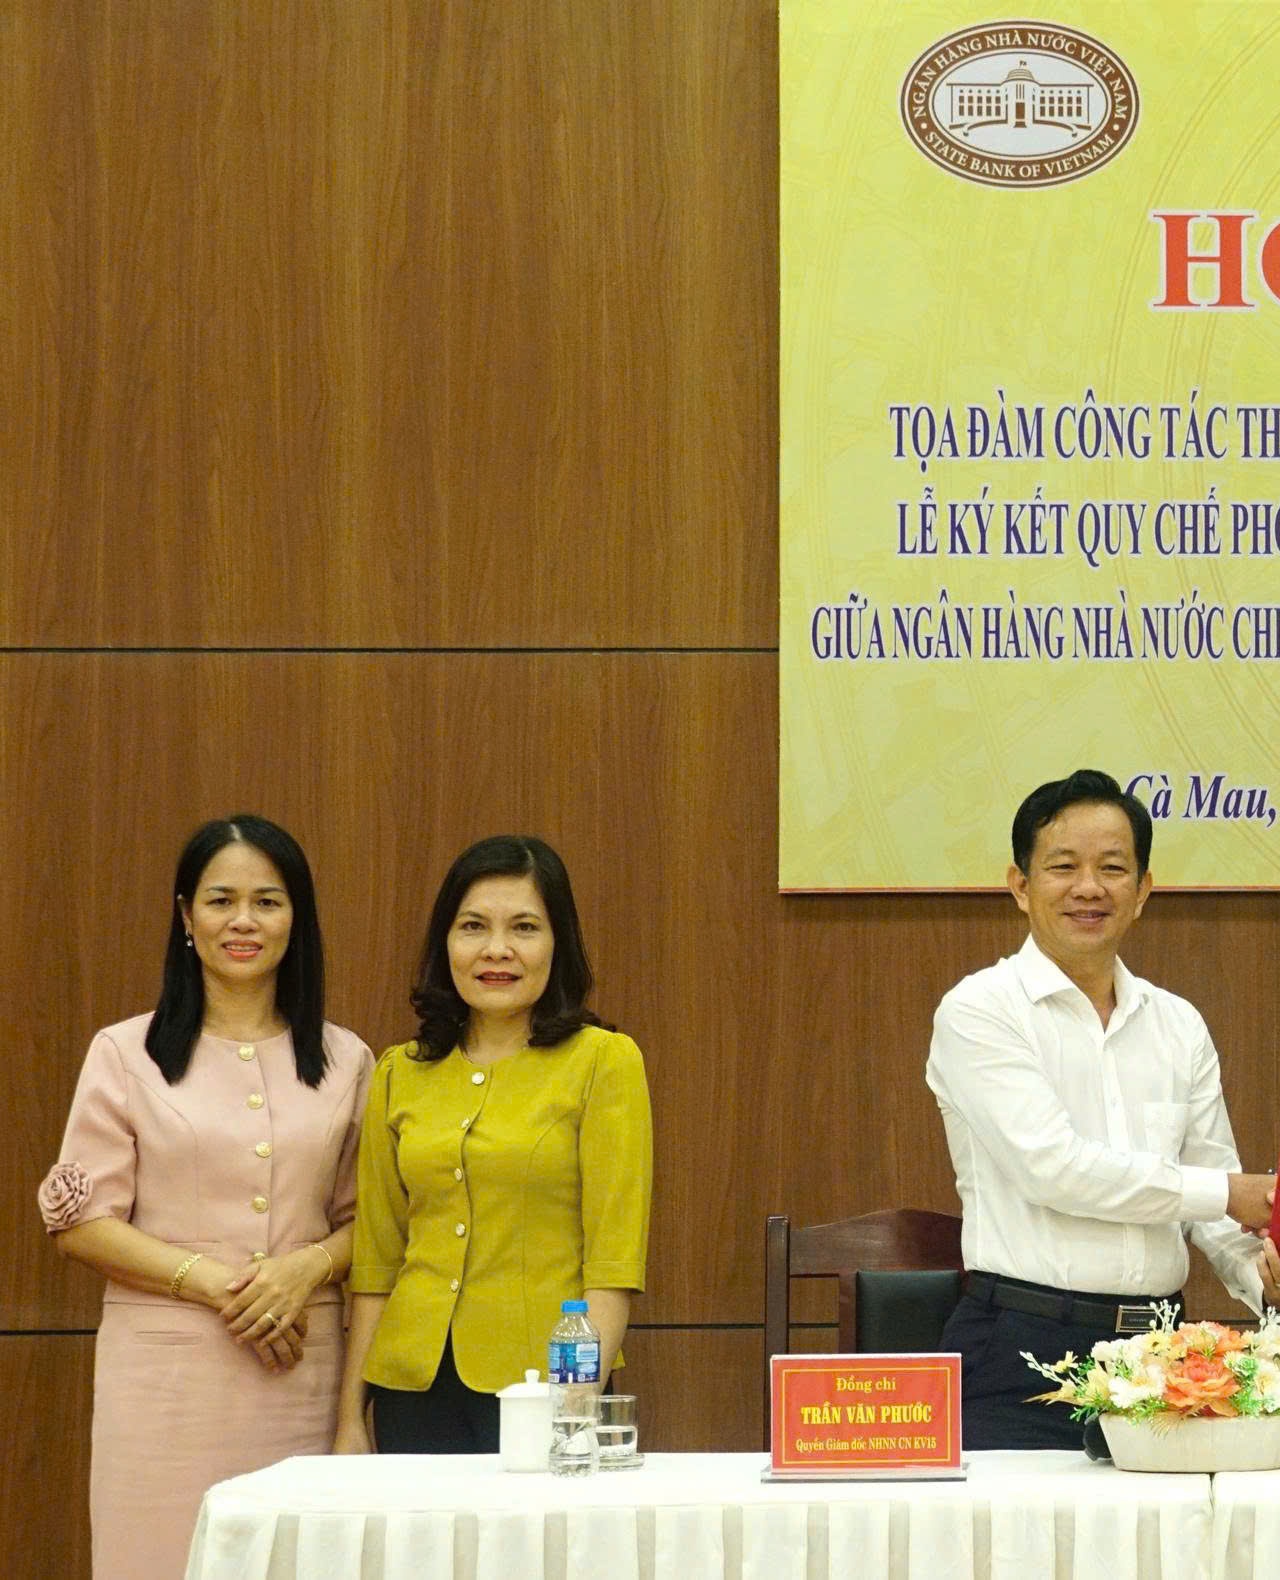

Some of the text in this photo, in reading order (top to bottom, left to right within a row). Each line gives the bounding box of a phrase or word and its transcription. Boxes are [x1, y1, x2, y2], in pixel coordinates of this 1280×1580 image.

[912, 30, 1129, 119] NGÂN HÀNG NHÀ NƯỚC VIỆT NAM
[924, 131, 1116, 178] STATE BANK OF VIETNAM
[889, 405, 960, 473] TỌA
[967, 389, 1045, 459] ĐÀM
[1054, 388, 1151, 459] CÔNG
[1160, 390, 1227, 459] TÁC
[897, 486, 938, 556] LỄ
[947, 487, 995, 556] KÝ
[1003, 486, 1069, 556] KẾT
[1077, 502, 1147, 569] QUY
[1153, 486, 1222, 556] CHẾ
[811, 592, 886, 660] GIỮA
[892, 589, 974, 660] NGÂN
[983, 590, 1066, 660] HÀNG
[1073, 590, 1134, 660] NHÀ
[1141, 590, 1225, 660] NƯỚC
[1181, 775, 1277, 828] Mau,
[836, 1374, 897, 1393] Đồng chí
[800, 1401, 933, 1425] TRẦN VĂN PHƯỚC
[825, 1437, 850, 1451] Giám
[868, 1437, 897, 1450] NHNN
[898, 1436, 912, 1450] CN
[913, 1436, 937, 1450] KV15
